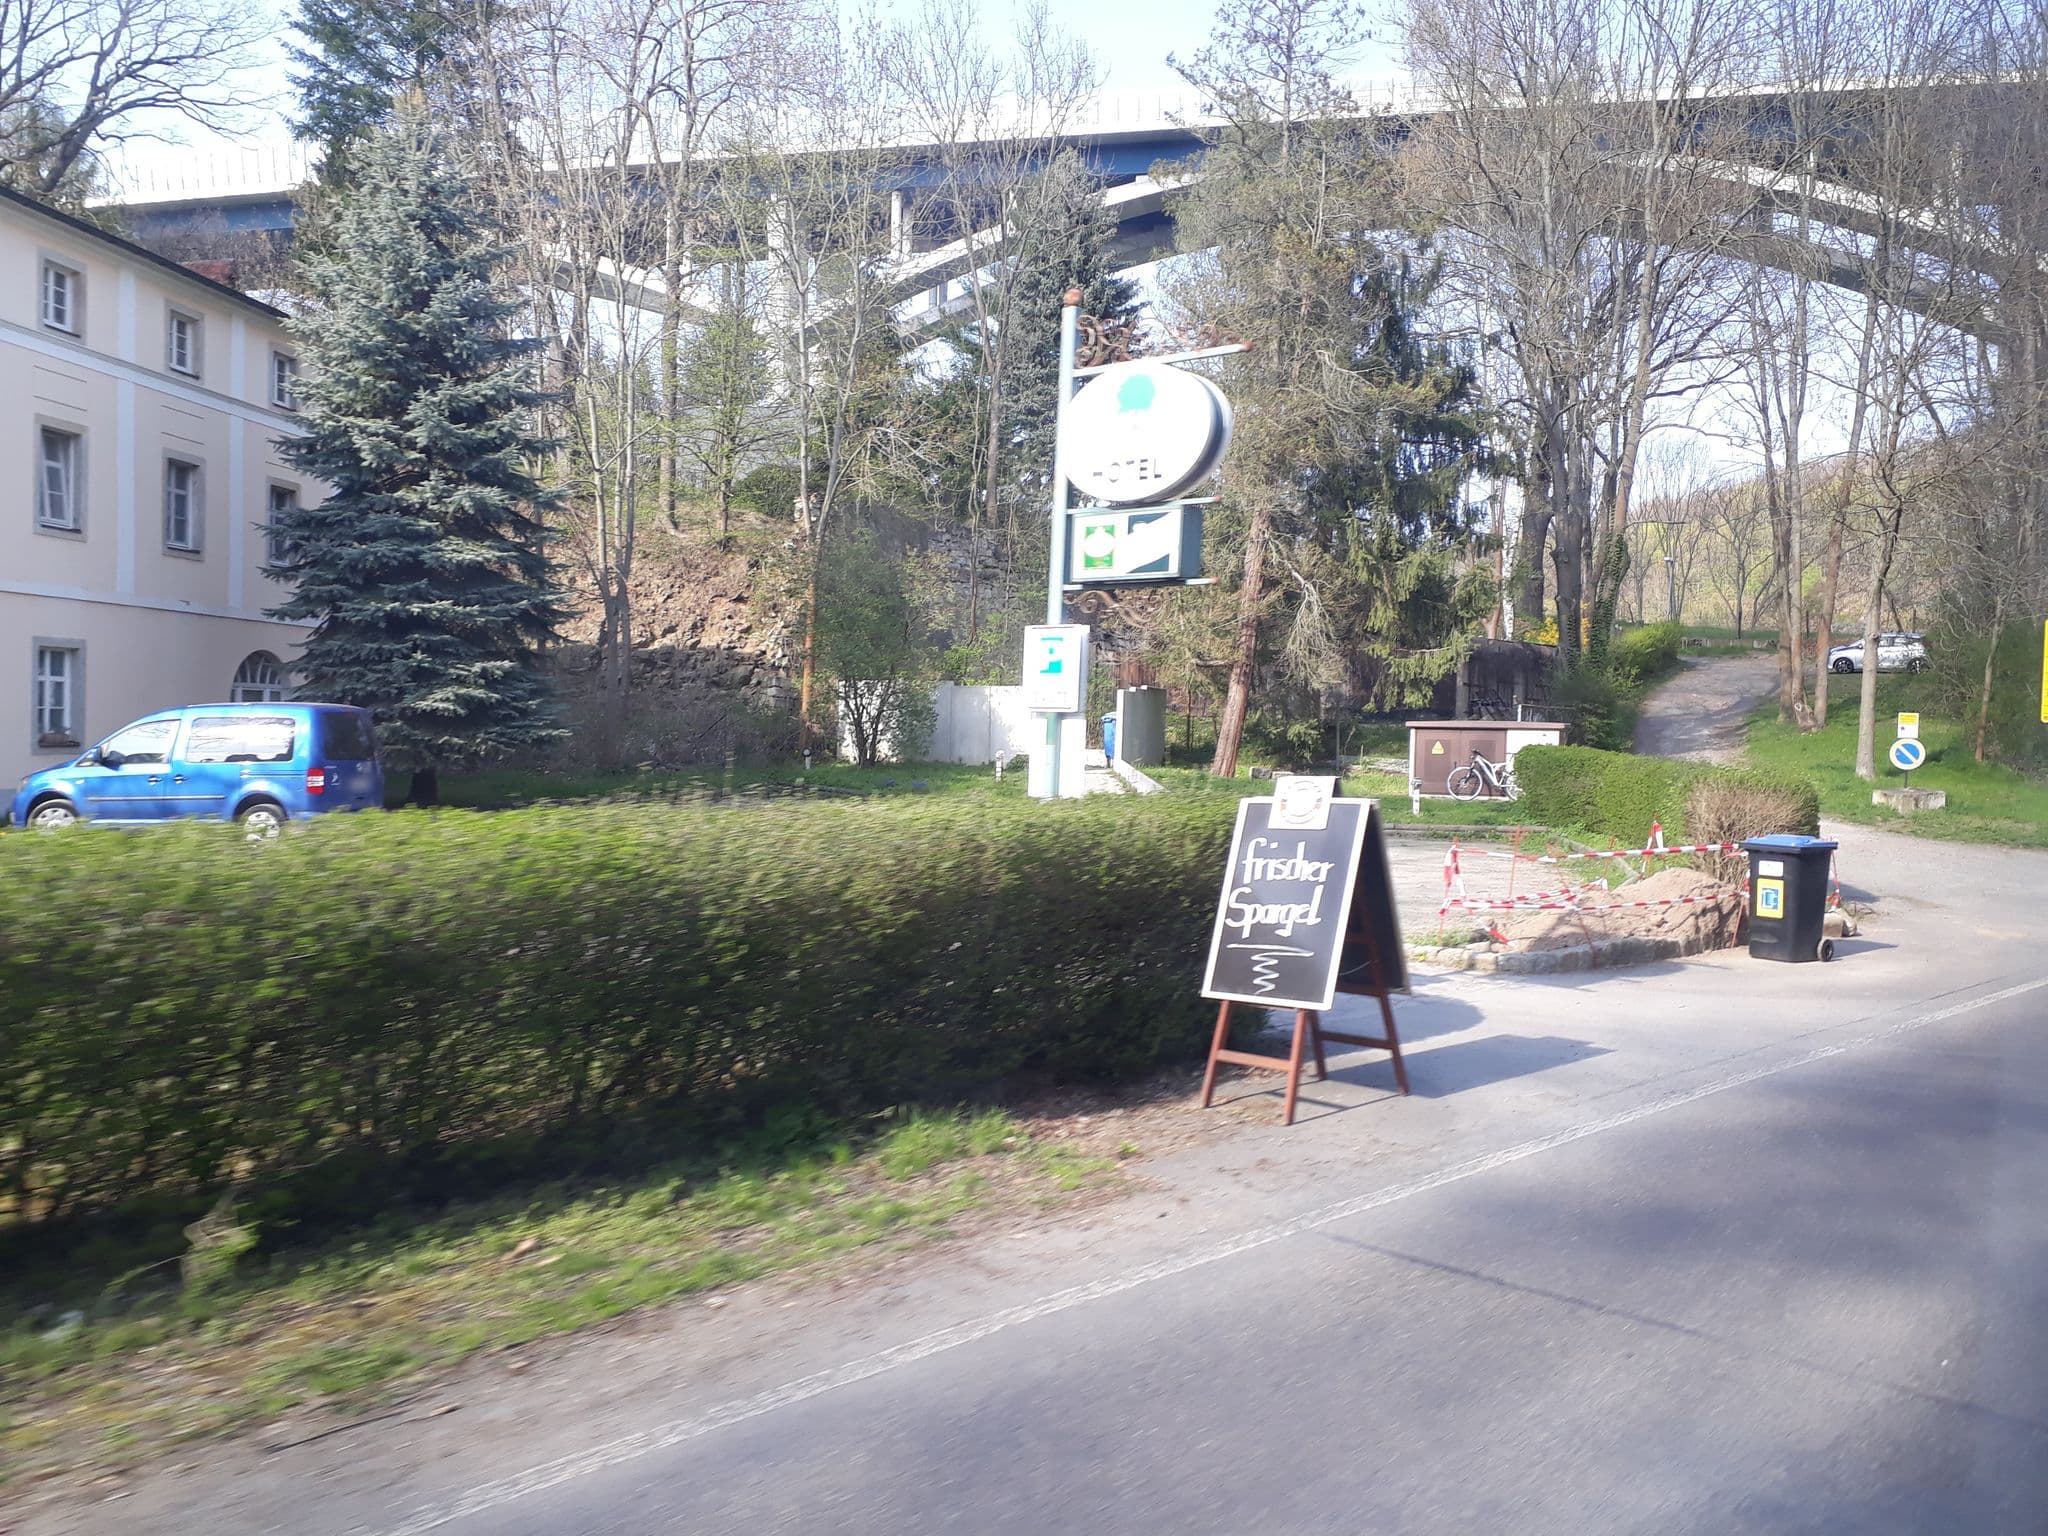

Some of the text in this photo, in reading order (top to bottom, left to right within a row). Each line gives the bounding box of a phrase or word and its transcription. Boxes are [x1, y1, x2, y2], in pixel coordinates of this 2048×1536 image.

[1090, 456, 1163, 485] OTEL
[1242, 837, 1335, 884] frischer
[1224, 884, 1325, 939] Spargel
